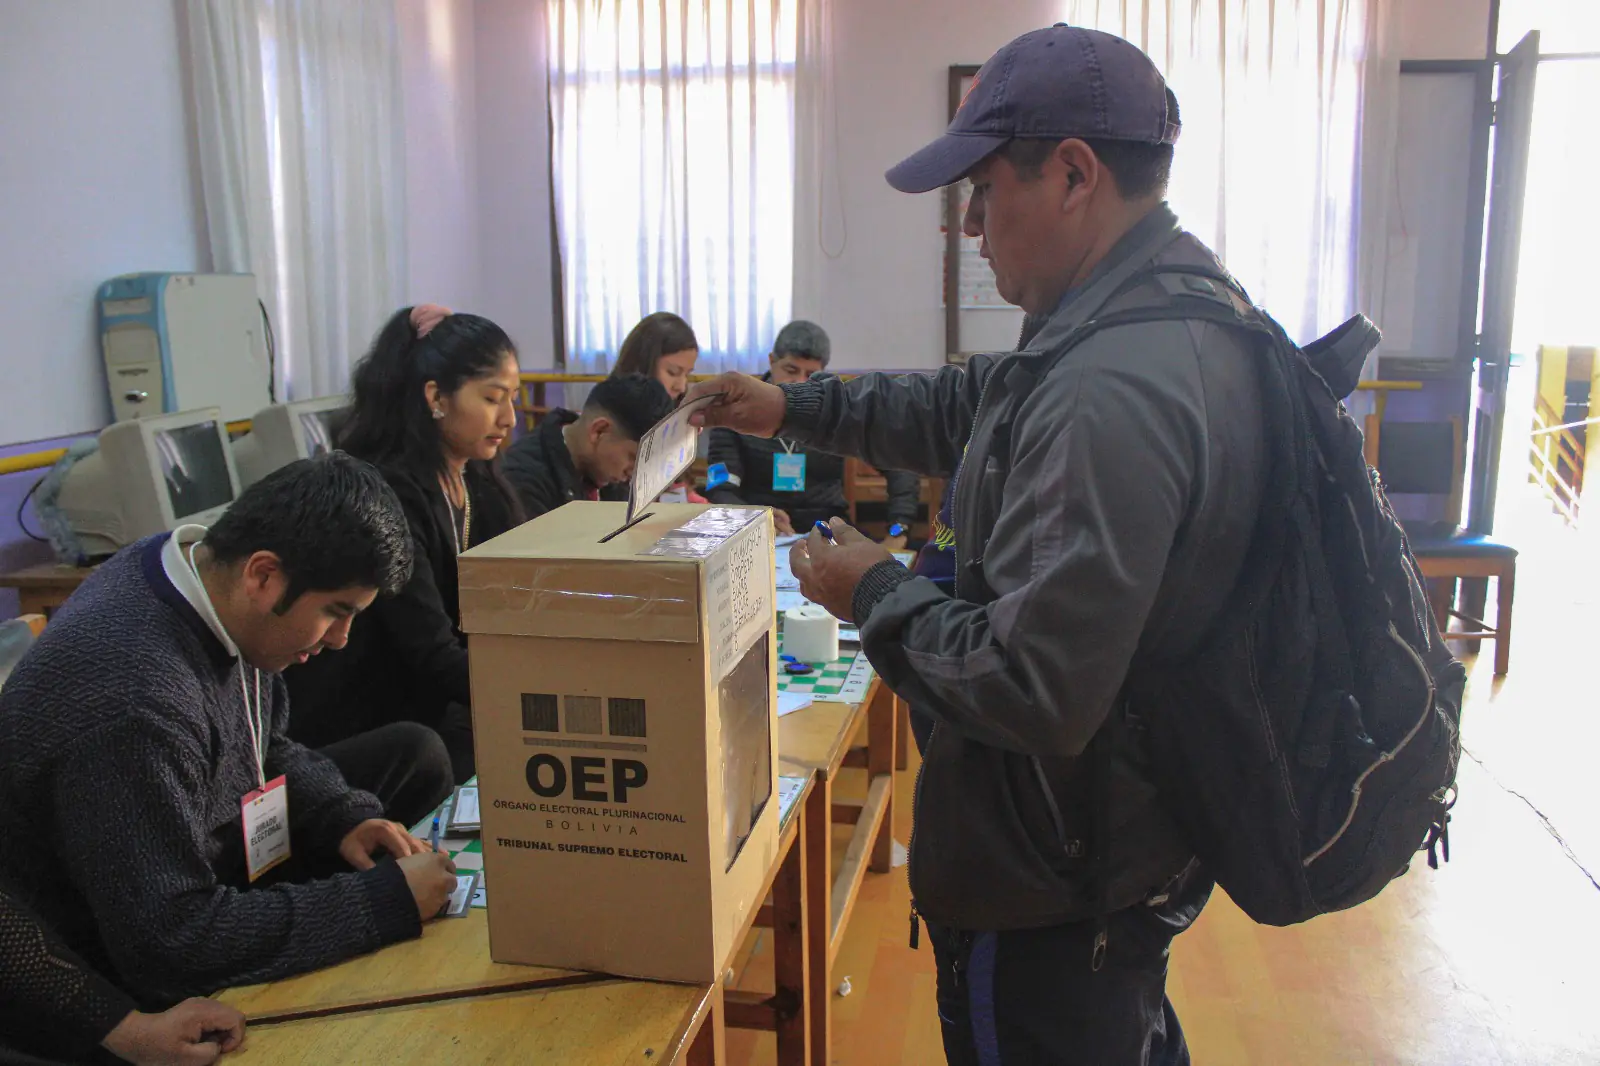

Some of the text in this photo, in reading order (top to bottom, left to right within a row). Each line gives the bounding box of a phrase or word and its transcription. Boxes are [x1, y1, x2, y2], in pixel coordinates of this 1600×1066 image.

[525, 753, 649, 804] OEP
[493, 799, 686, 824] ÓRGANO ELECTORAL PLURINACIONAL
[545, 819, 638, 836] BOLIVIA
[496, 837, 688, 863] TRIBUNAL SUPREMO ELECTORAL
